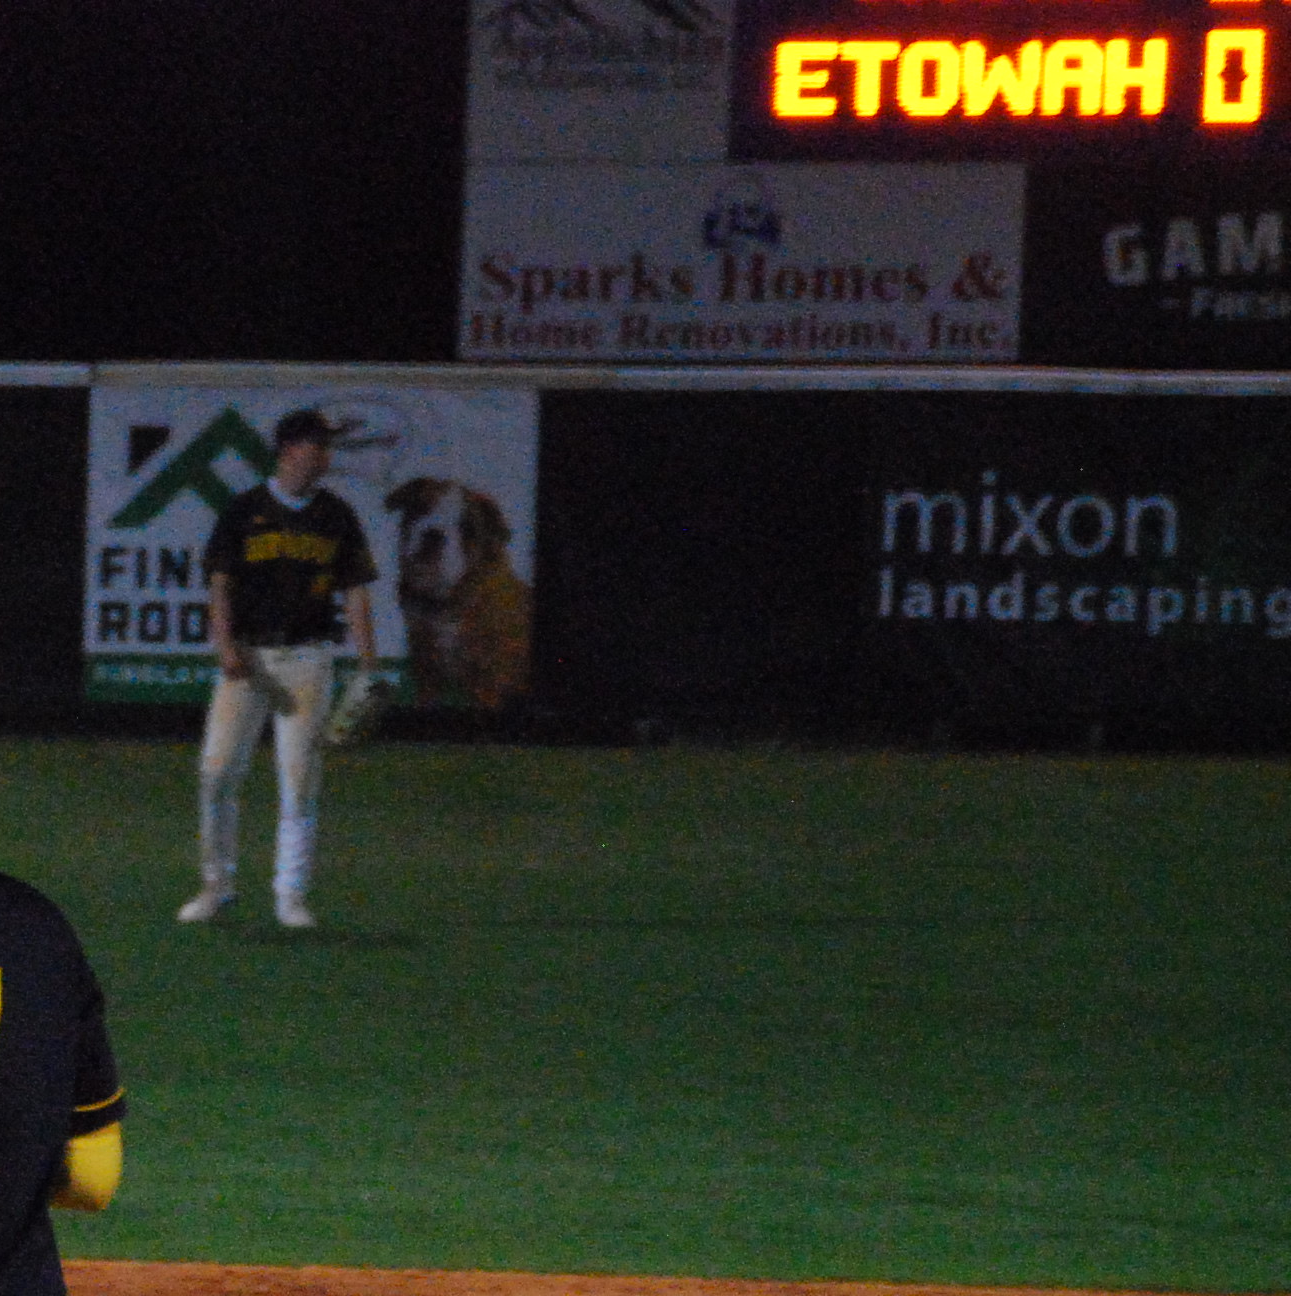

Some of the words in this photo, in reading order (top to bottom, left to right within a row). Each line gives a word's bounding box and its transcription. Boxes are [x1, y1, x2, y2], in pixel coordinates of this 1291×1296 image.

[773, 38, 1169, 118] ETOWAH
[1204, 28, 1266, 124] 0
[479, 252, 695, 312] Sparks
[719, 254, 931, 303] Homes
[951, 254, 1009, 303] &
[470, 315, 599, 347] Home
[882, 469, 1178, 558] mixon
[877, 567, 1291, 638] landscaping
